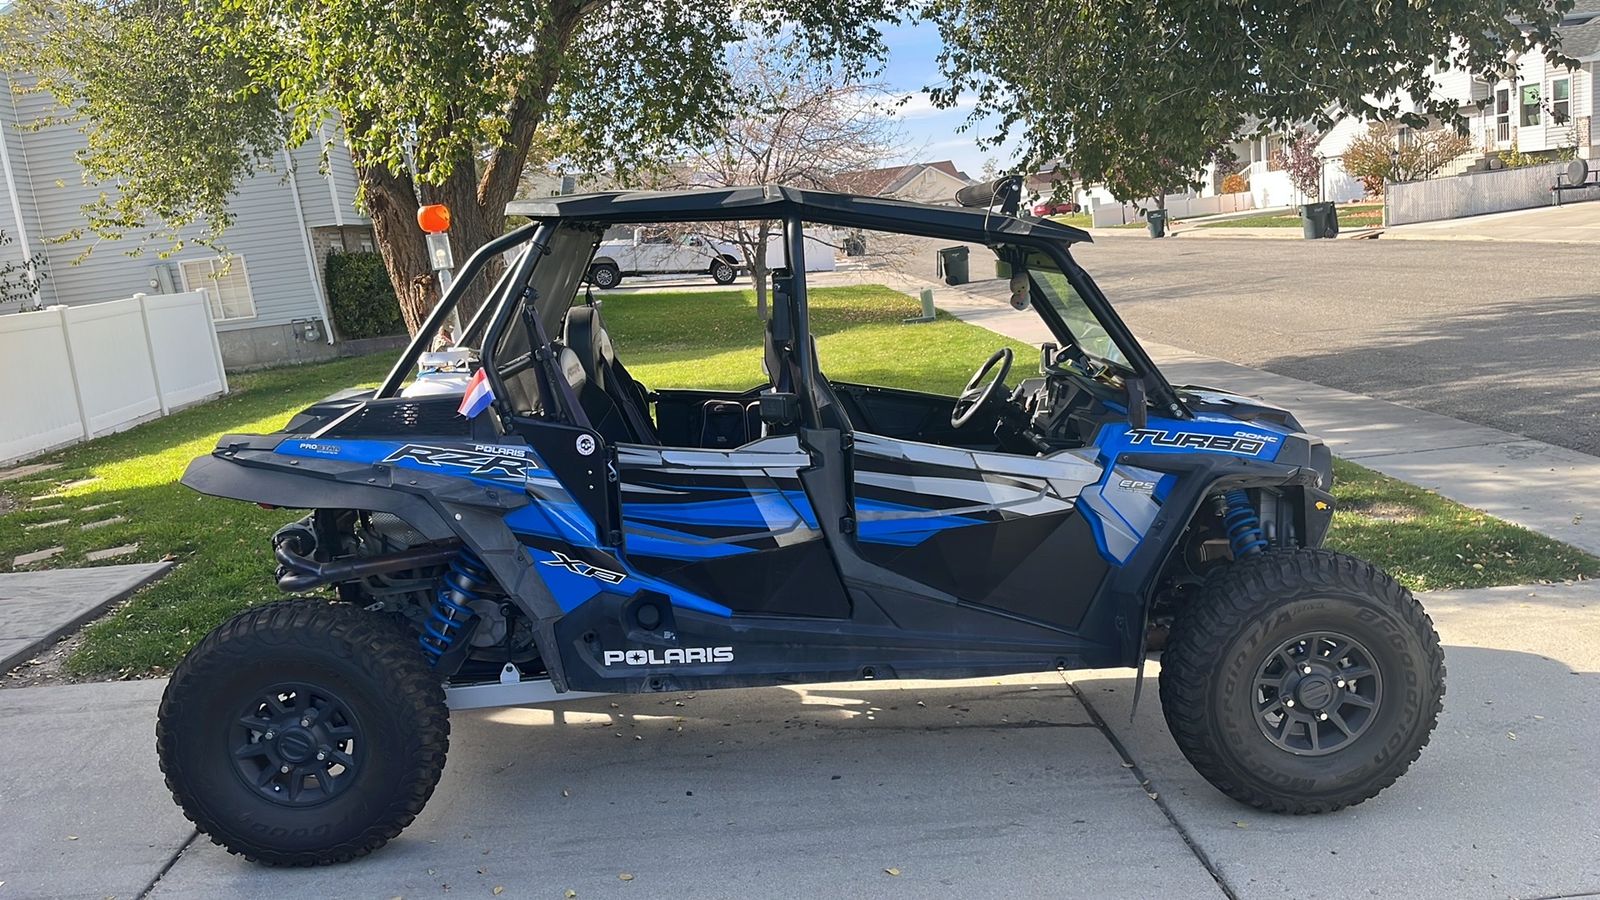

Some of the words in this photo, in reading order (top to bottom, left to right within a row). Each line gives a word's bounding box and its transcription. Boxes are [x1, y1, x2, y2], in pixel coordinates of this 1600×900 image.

[1124, 428, 1265, 456] TURBO
[1233, 431, 1278, 443] DOHC
[382, 443, 539, 479] RZR
[475, 444, 526, 458] POLARIS
[1119, 479, 1155, 490] EPS
[539, 550, 627, 585] XP
[603, 646, 734, 666] POLARIS
